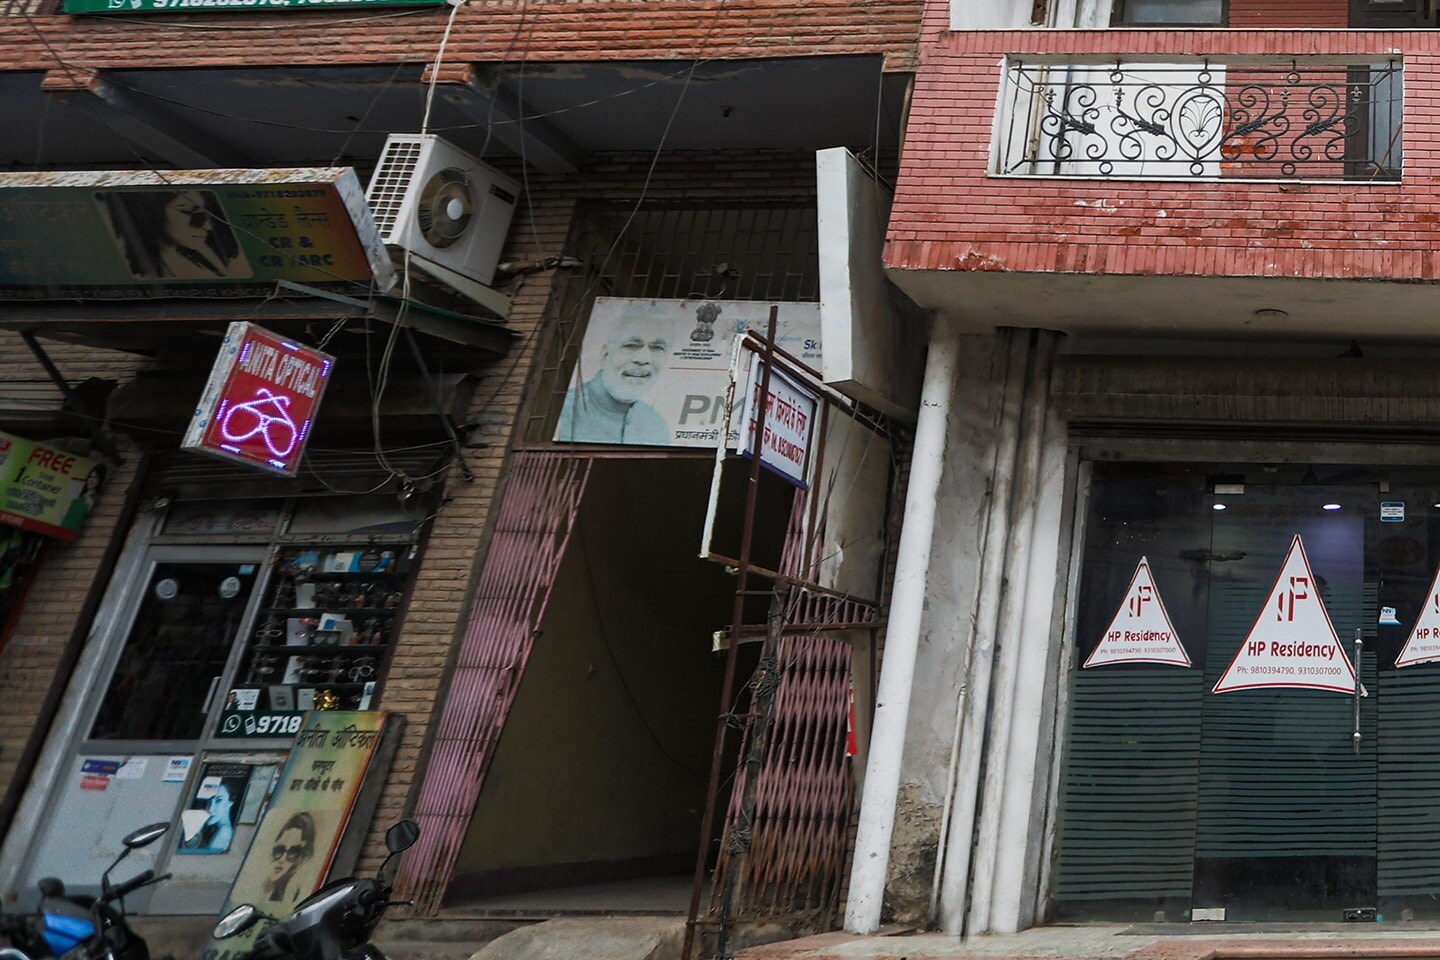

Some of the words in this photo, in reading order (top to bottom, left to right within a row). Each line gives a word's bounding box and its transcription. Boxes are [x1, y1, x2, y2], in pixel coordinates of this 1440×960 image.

[298, 235, 314, 248] &
[238, 340, 280, 382] ANITA
[274, 353, 321, 399] OPTICAL
[675, 428, 719, 440] प्रधानमंत्री
[28, 447, 76, 475] FREE
[1107, 631, 1121, 642] HP
[1124, 630, 1171, 643] Residency
[1416, 627, 1429, 639] HP
[1247, 641, 1266, 657] HP
[1270, 640, 1336, 661] Residency
[1237, 666, 1248, 674] Ph:
[1250, 666, 1296, 675] 9810394790,
[1297, 666, 1341, 675] 9310307000
[297, 723, 330, 750] अनीता
